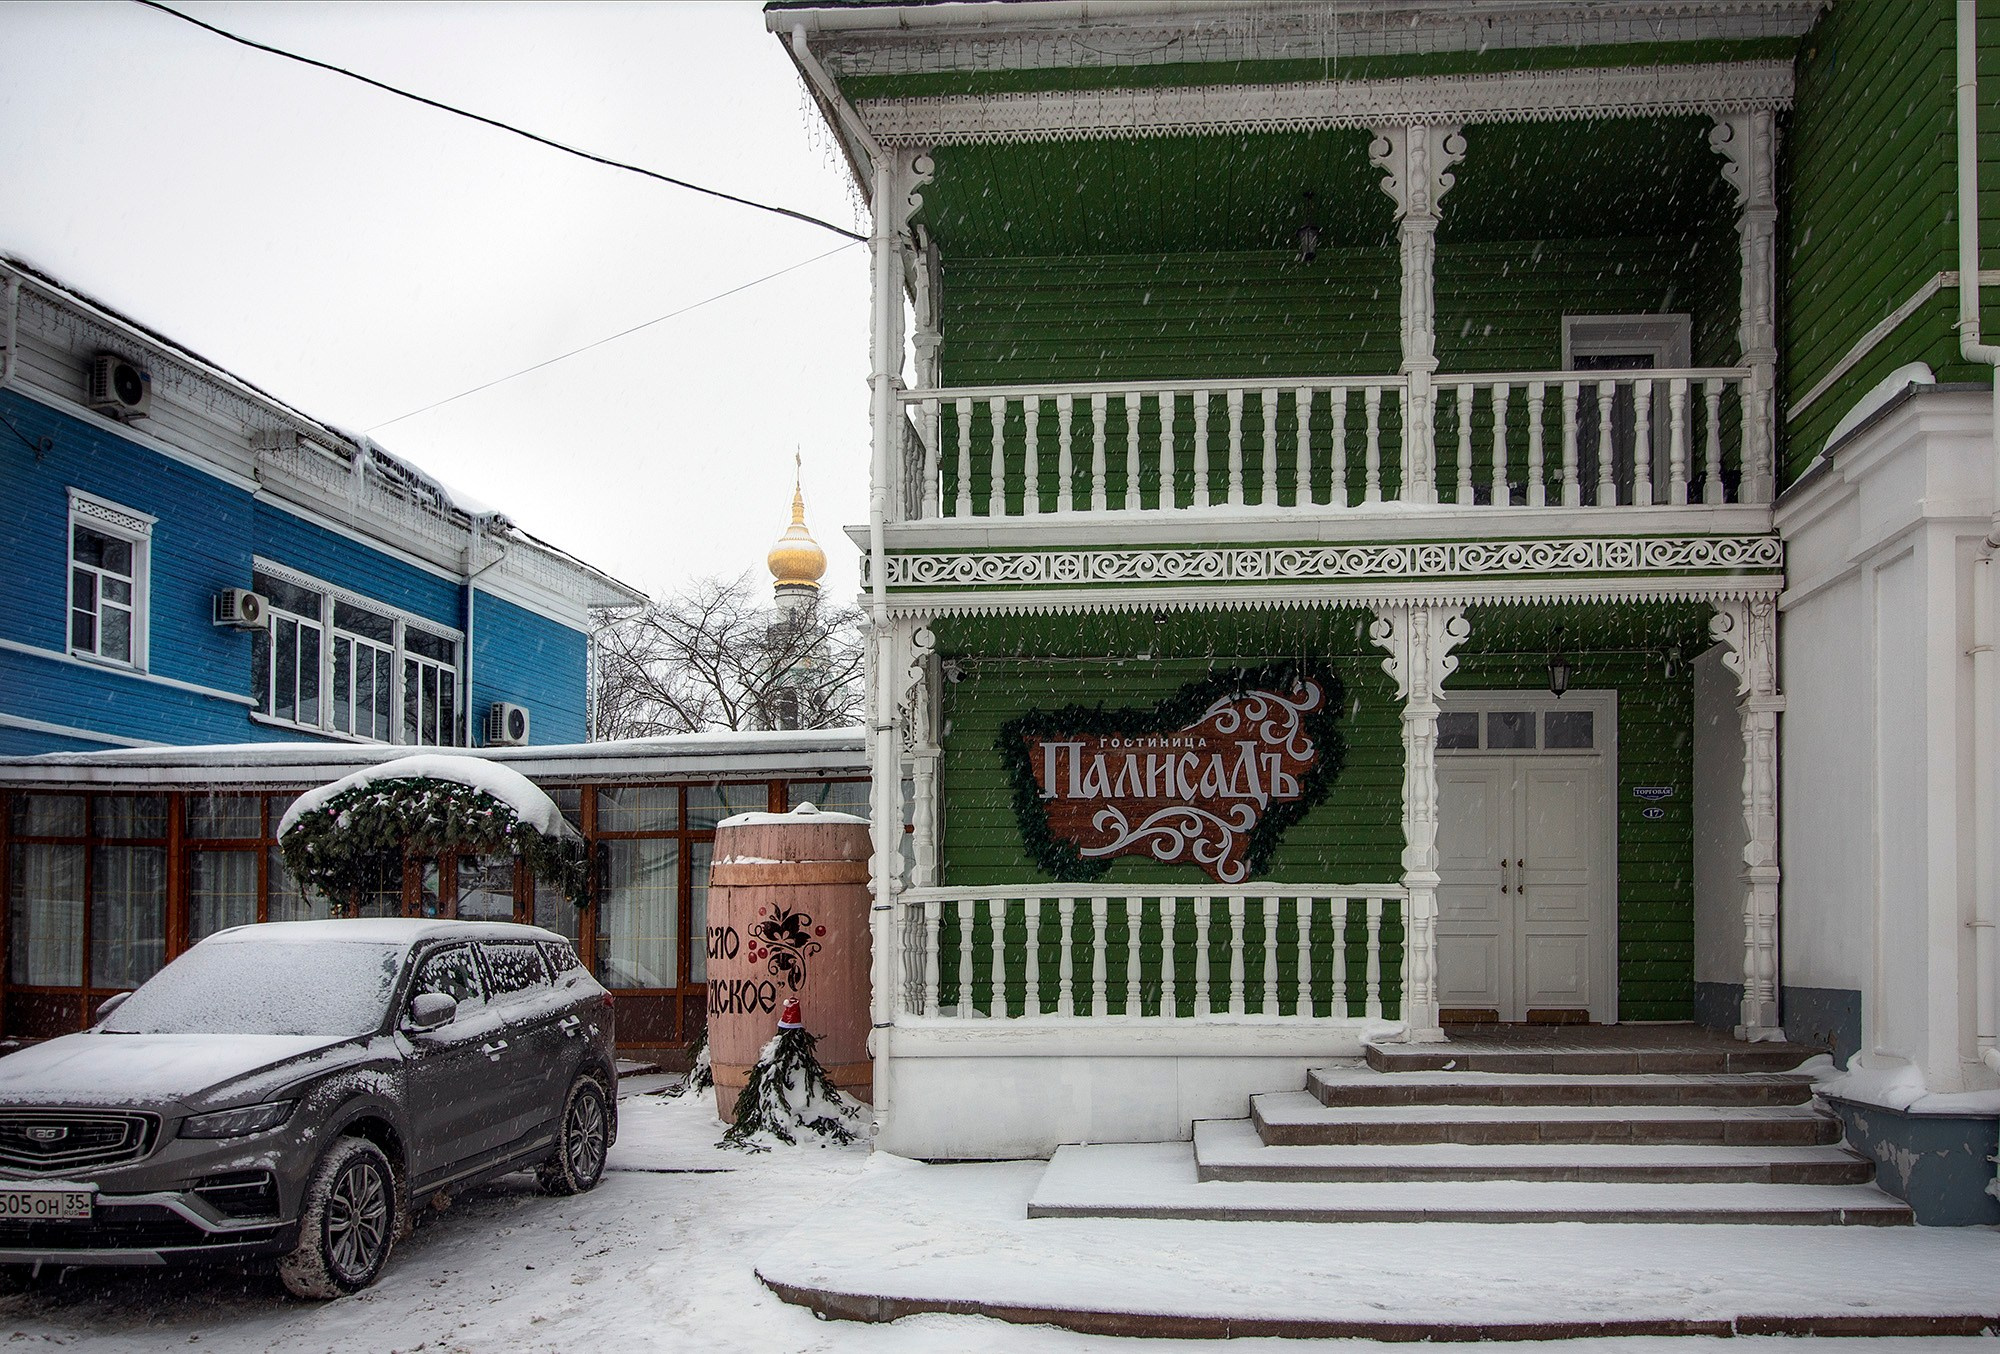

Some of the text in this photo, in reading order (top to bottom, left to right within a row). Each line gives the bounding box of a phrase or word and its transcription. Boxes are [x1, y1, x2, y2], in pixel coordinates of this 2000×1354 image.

[1100, 737, 1207, 749] ГОСТИНИЦА
[1649, 809, 1660, 817] 17
[706, 926, 740, 960] сло
[66, 1194, 84, 1210] 35
